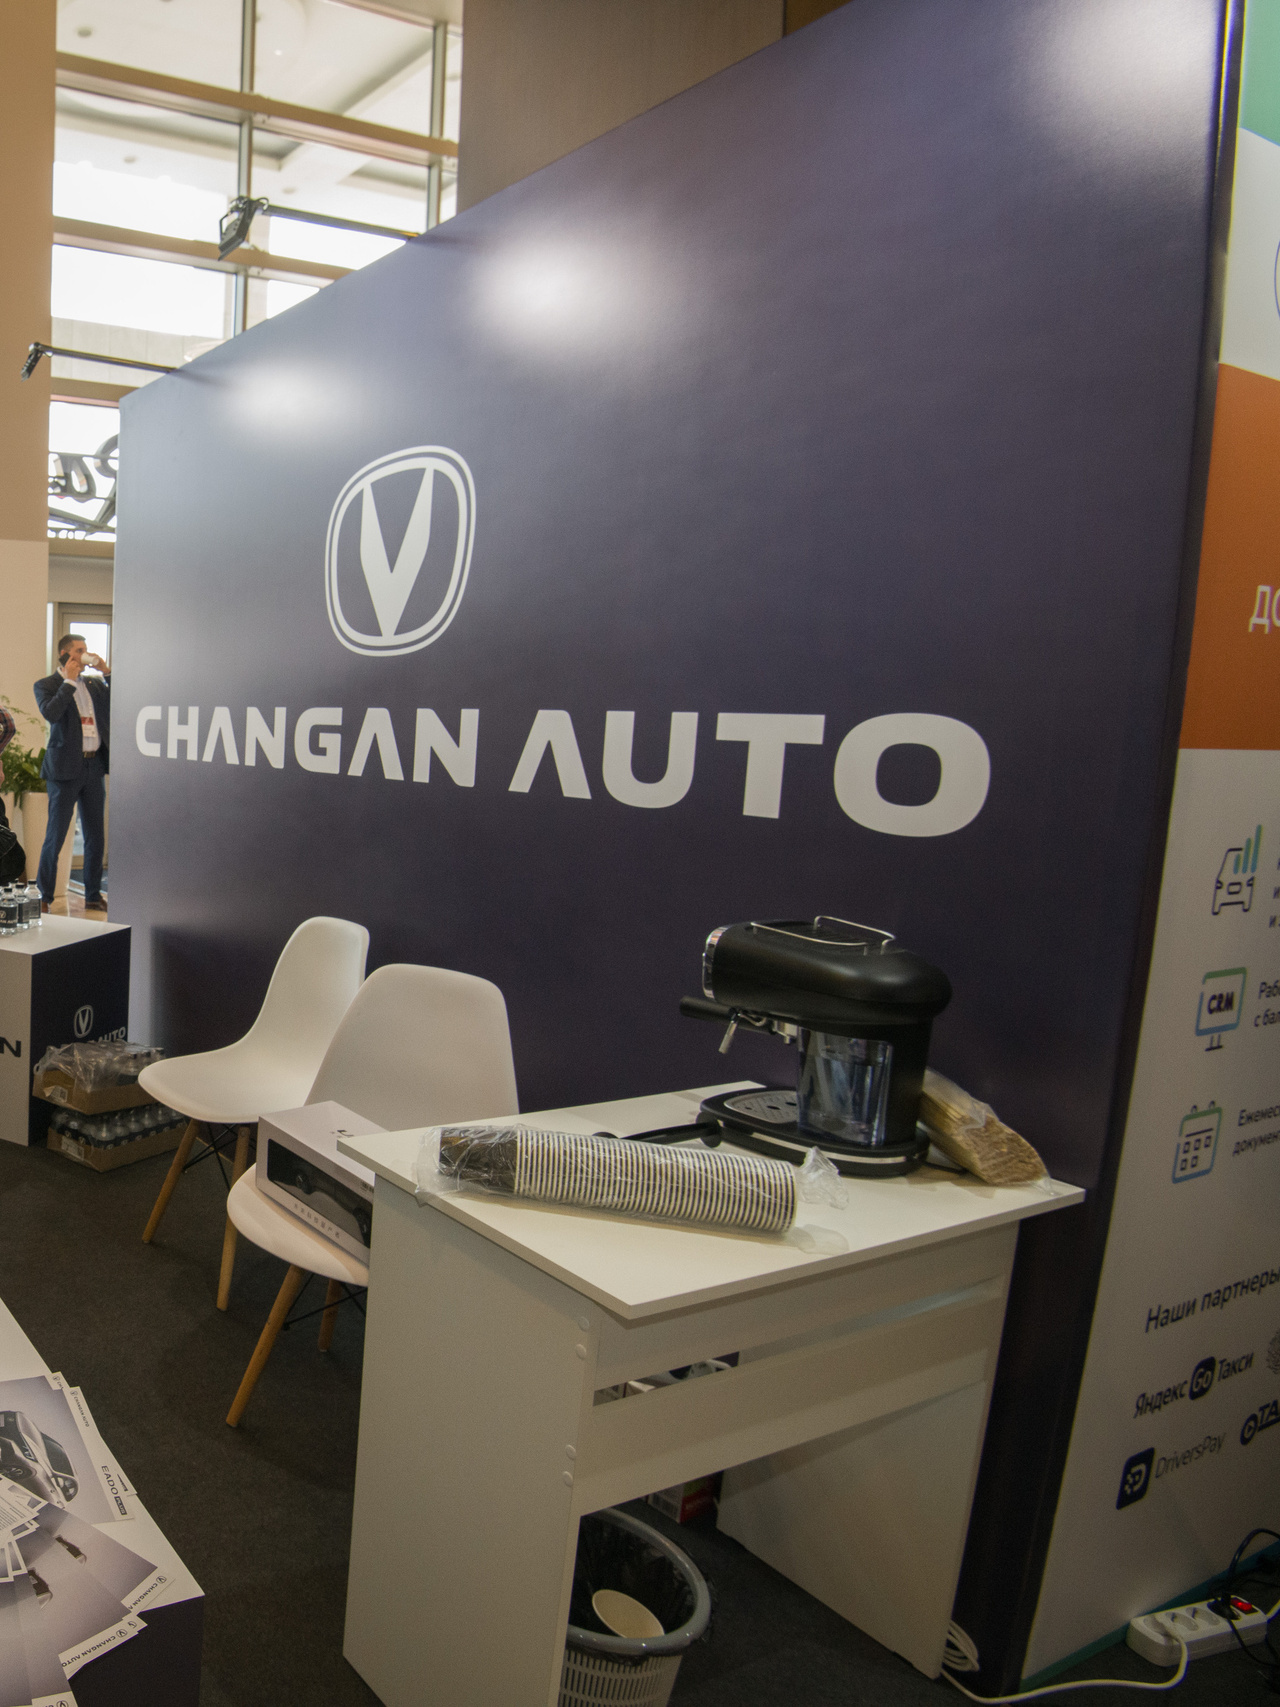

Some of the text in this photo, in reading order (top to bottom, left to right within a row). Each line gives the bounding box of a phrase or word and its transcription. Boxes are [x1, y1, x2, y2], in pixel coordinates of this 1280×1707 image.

[136, 706, 992, 838] CHANGAN AUTO
[1207, 991, 1235, 1015] CRM
[1145, 1298, 1197, 1334] Наши
[1133, 1351, 1254, 1419] Яндекс Go Такси
[1155, 1432, 1227, 1479] DriversPay
[101, 1464, 128, 1516] EADO PLUS
[61, 1635, 116, 1667] CHANGAN AUTO
